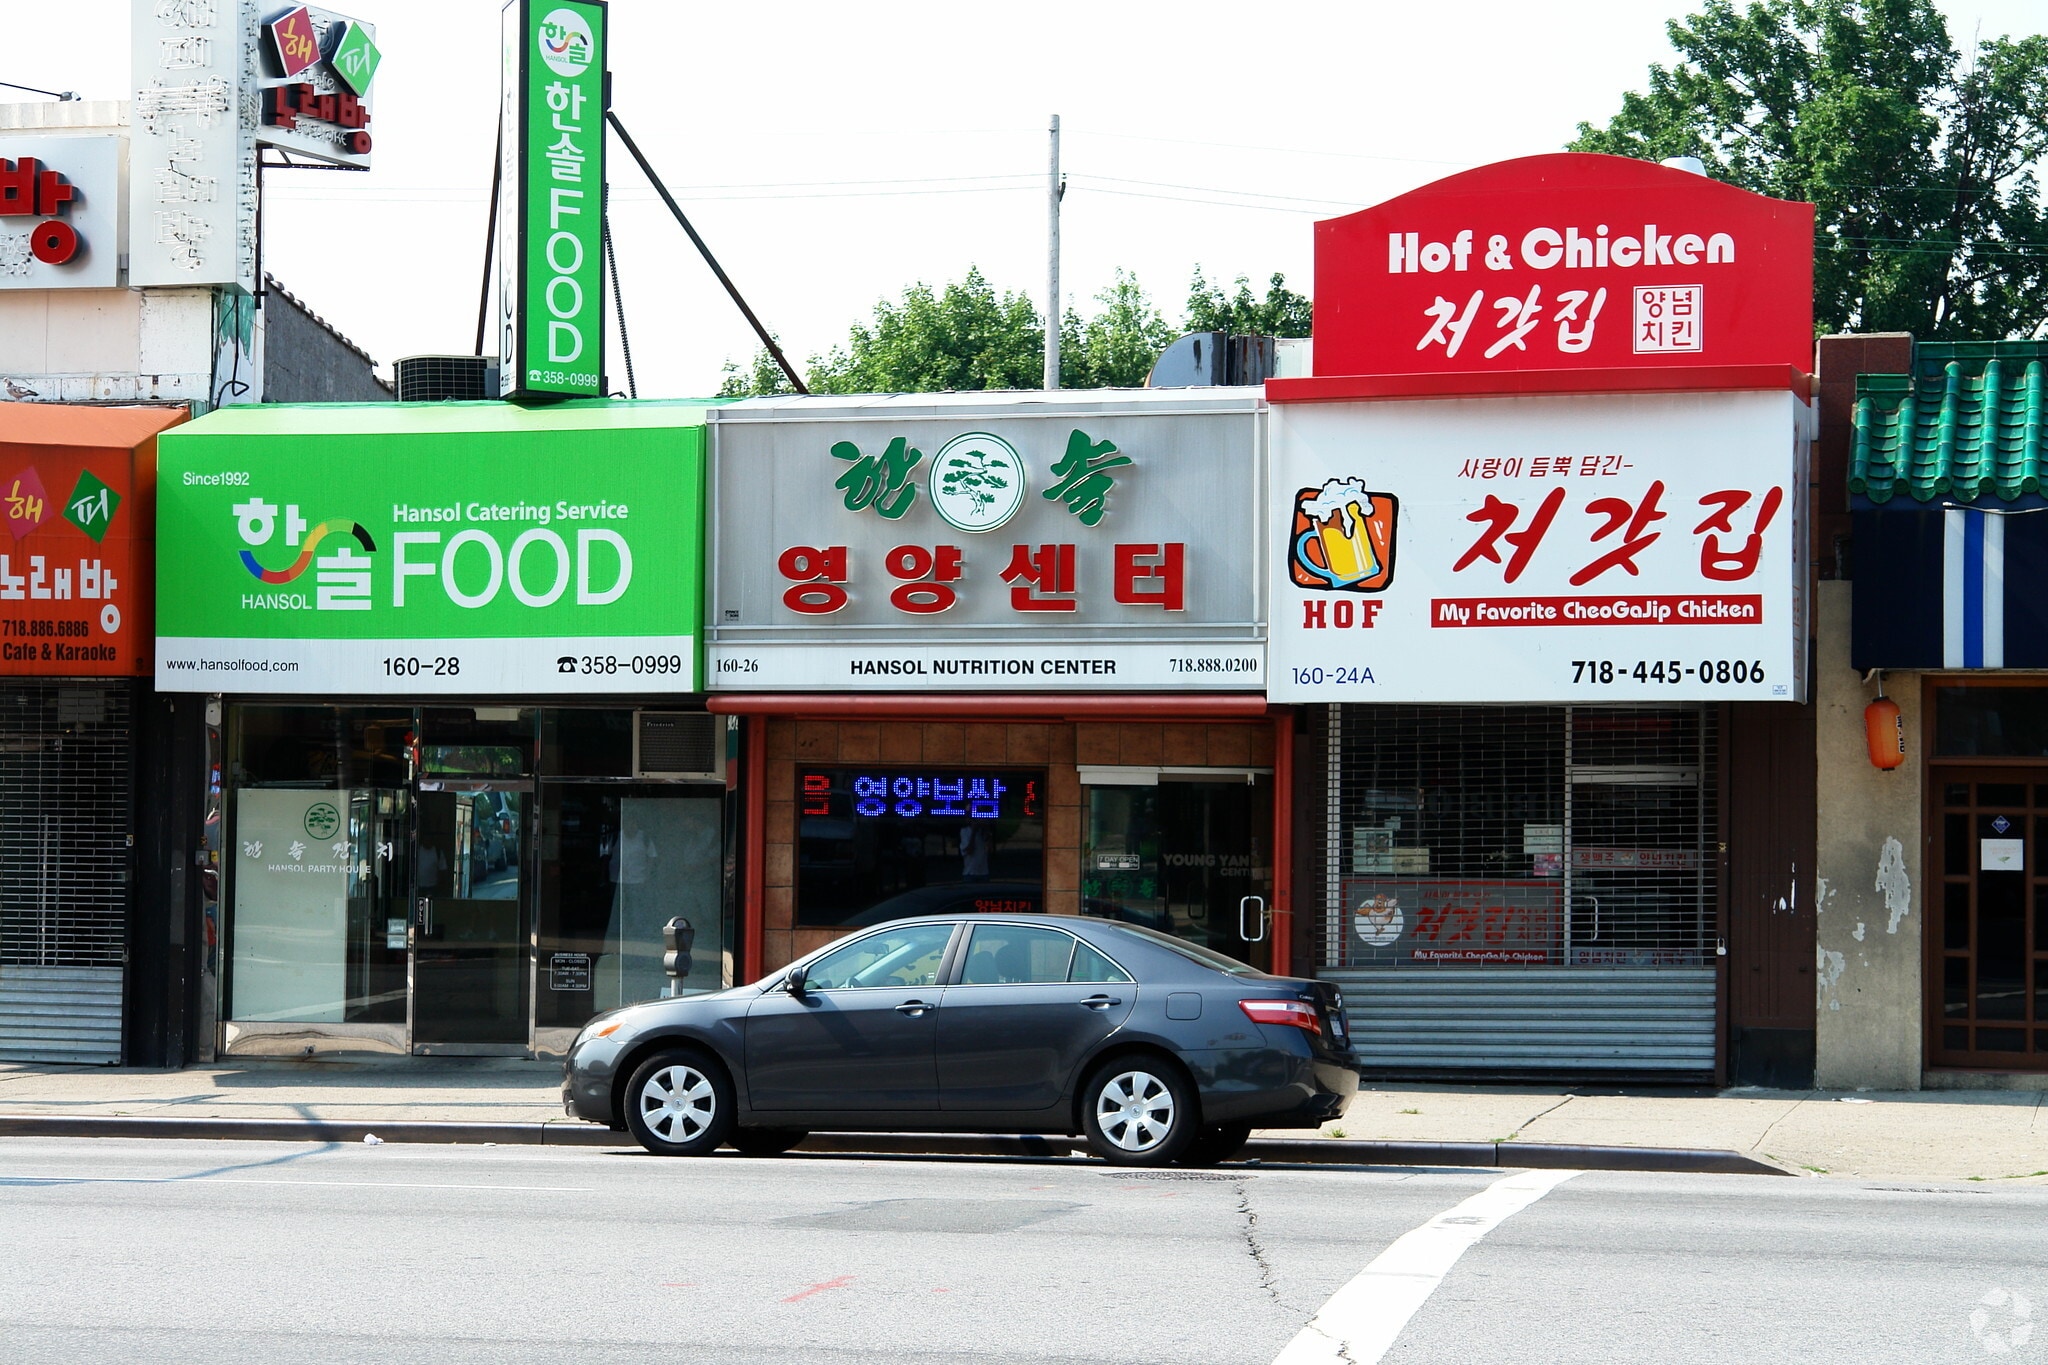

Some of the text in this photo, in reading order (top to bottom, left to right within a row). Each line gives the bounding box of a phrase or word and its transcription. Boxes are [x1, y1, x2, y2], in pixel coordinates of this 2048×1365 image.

[282, 17, 313, 64] 해
[545, 54, 568, 64] HANSOL
[275, 83, 372, 155] 노래방
[545, 81, 587, 364] 한솔 FOOD
[1388, 223, 1736, 274] Hof & Chicken
[1642, 290, 1693, 317] 양념
[1416, 283, 1608, 359] 처갓집
[1642, 319, 1693, 347] 치킨
[543, 370, 598, 388] 358-0999
[1458, 457, 1523, 480] 사랑이
[1529, 456, 1571, 478] 듬뿍
[4, 479, 44, 524] 해
[393, 500, 629, 525] Hansol Catering Service
[1452, 479, 1784, 587] 처갓집
[393, 527, 634, 609] FOOD
[777, 542, 1187, 616] 영양센터
[0, 554, 121, 635] 노래방
[241, 593, 313, 610] HANSOL
[1302, 598, 1384, 630] HOF
[1438, 598, 1755, 626] My Favorite CheoGaJip Chicken
[2, 619, 89, 637] 718.886.6886
[2, 642, 117, 661] Cafe & Karaoke
[166, 658, 299, 674] www.hansolfood.com
[383, 657, 460, 676] 160-28
[581, 656, 682, 676] 358-0999
[715, 657, 759, 674] 160-26
[850, 659, 1117, 676] HANSOL NUTRITION CENTER
[1169, 656, 1258, 674] 718.888.0200
[1292, 666, 1376, 685] 160-24A
[1571, 660, 1766, 685] 718-445-0806
[854, 776, 1007, 819] 영양보쌈
[268, 864, 305, 873] HANSOL
[308, 864, 338, 874] PARTY
[1162, 853, 1216, 867] YOUNG
